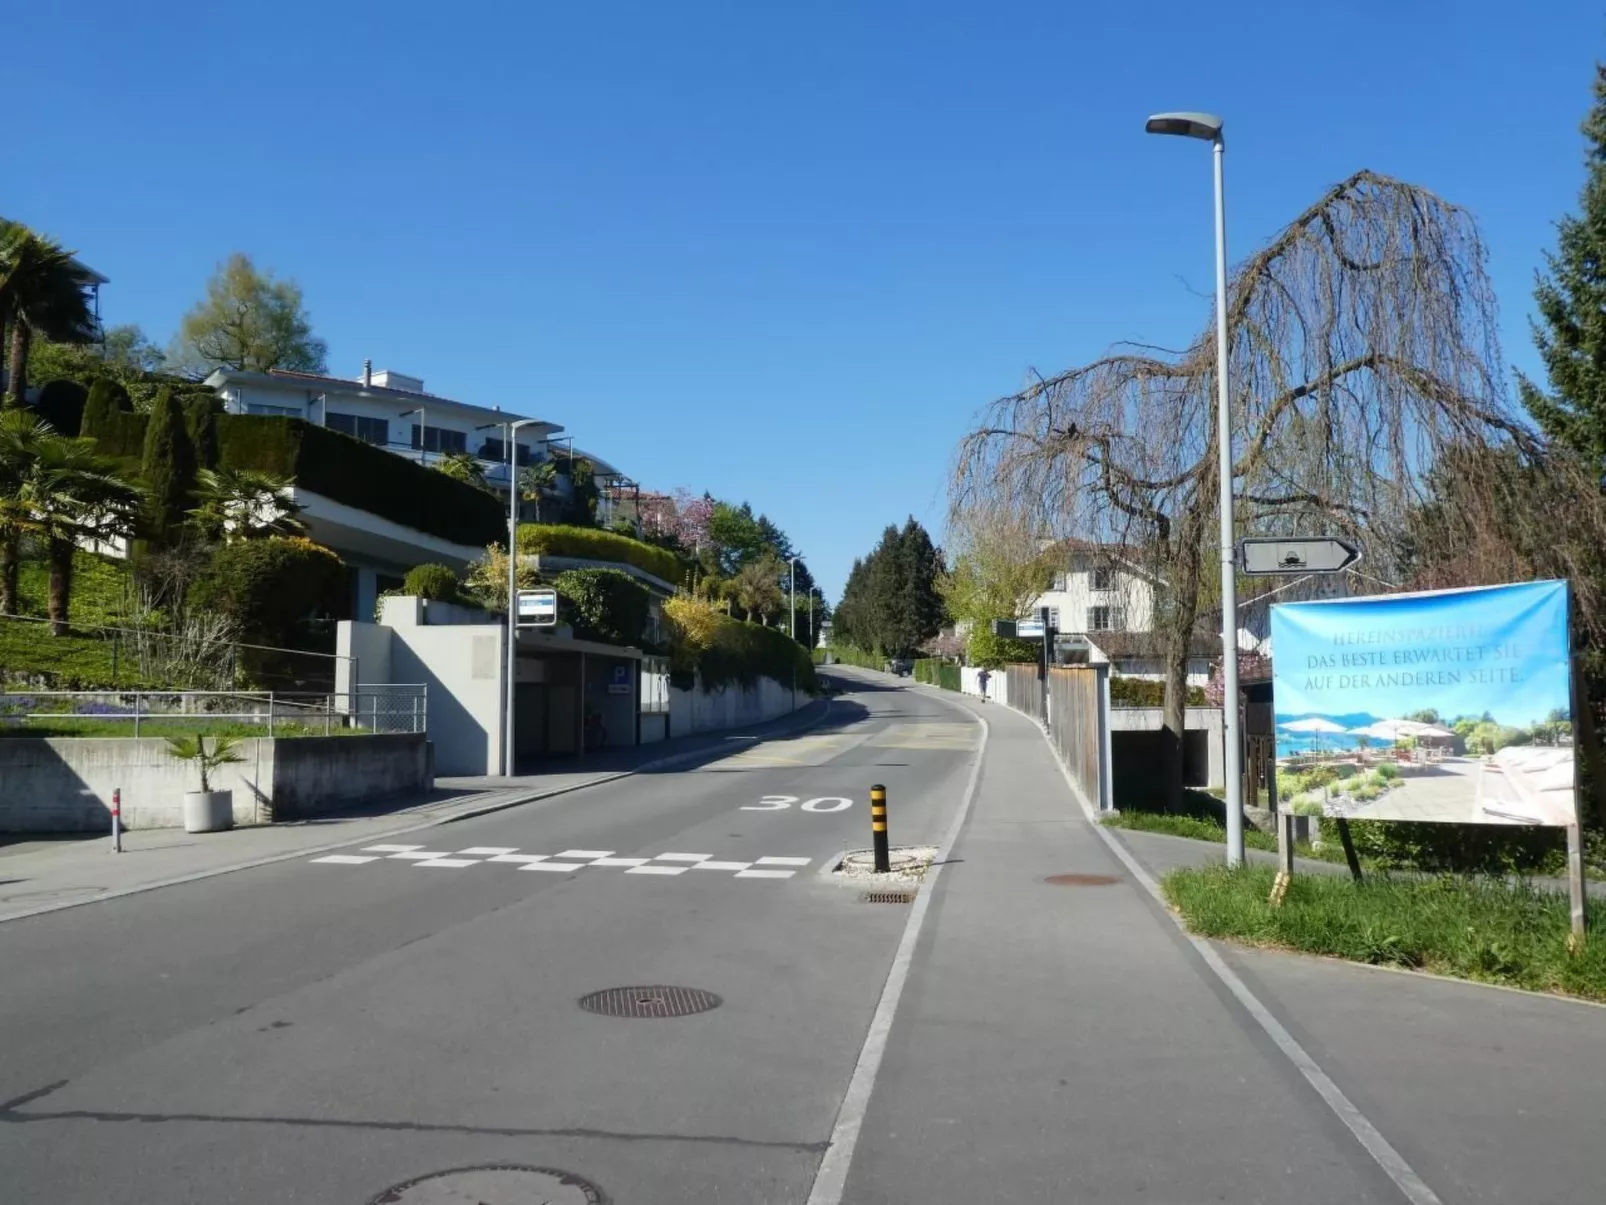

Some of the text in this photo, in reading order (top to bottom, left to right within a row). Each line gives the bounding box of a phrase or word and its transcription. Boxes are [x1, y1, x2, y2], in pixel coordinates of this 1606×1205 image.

[1307, 642, 1522, 669] DAS BESTE ERWARTET SIE
[614, 666, 625, 683] P
[1304, 674, 1334, 691] AUF
[1339, 673, 1371, 689] DER
[1376, 670, 1461, 688] ANDEREN
[739, 795, 853, 812] 30
